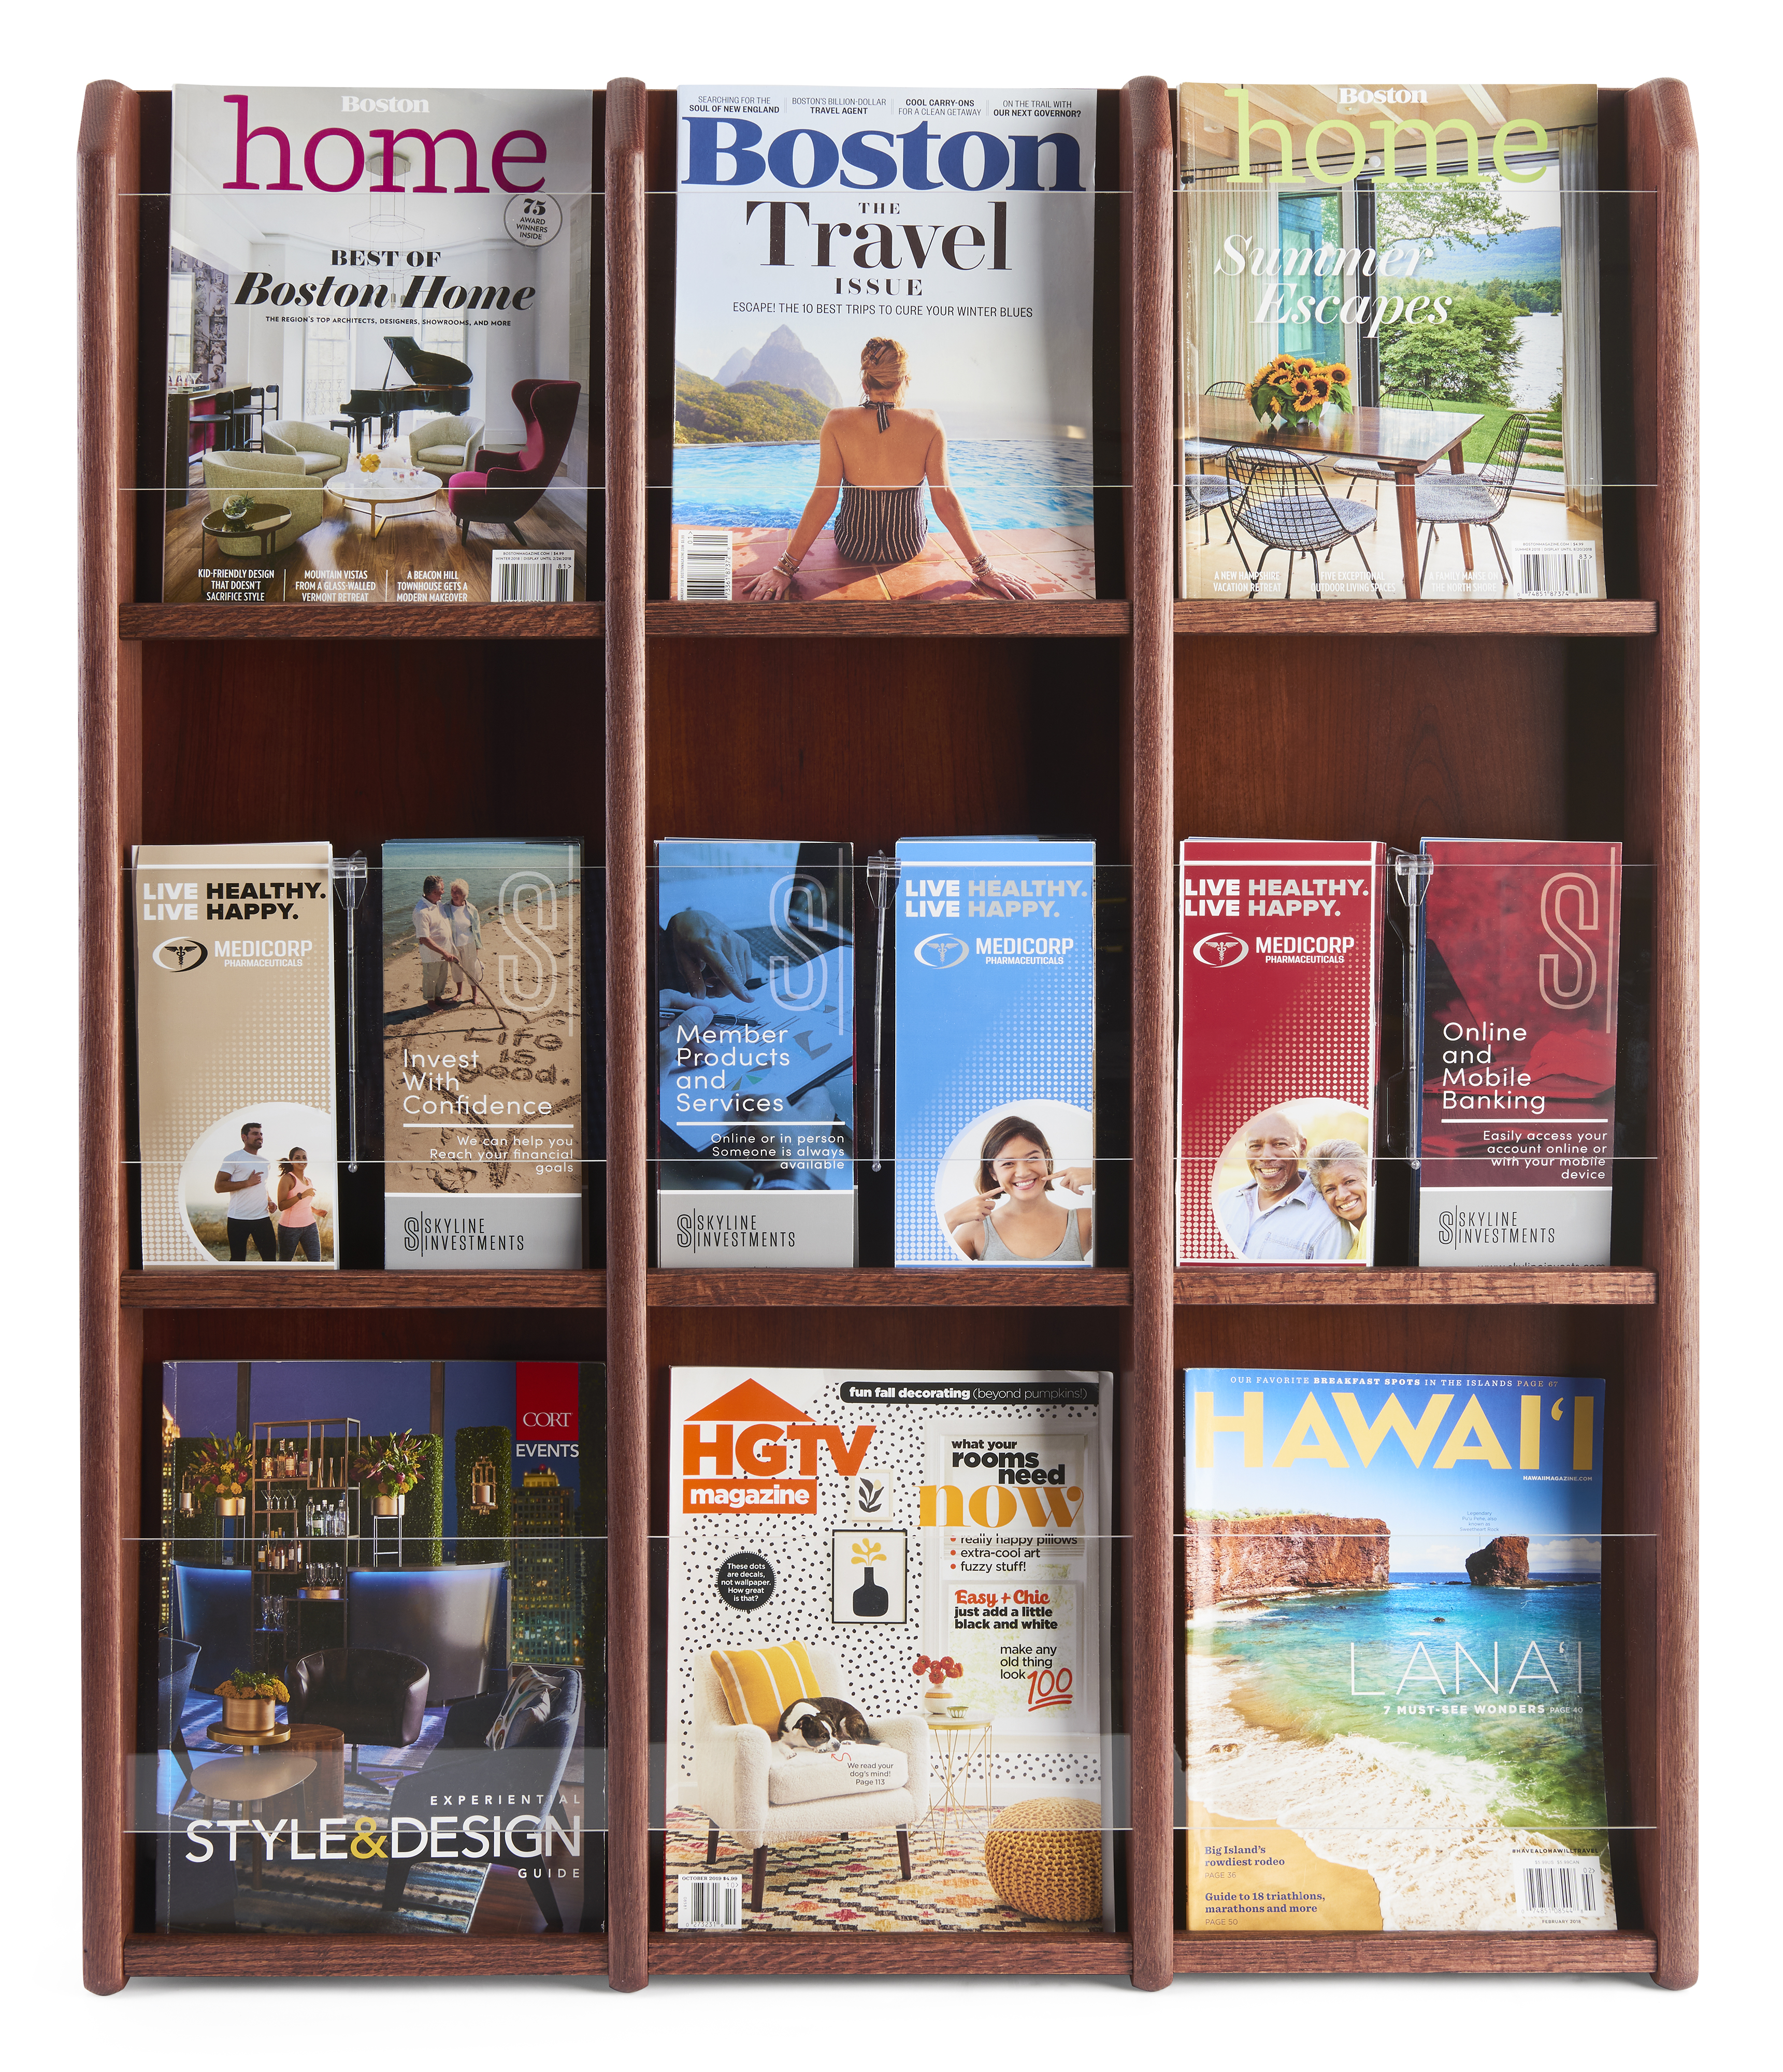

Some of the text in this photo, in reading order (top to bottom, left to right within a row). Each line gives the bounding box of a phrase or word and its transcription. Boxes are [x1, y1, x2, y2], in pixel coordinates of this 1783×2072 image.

[341, 96, 430, 113] Boston
[698, 95, 771, 105] SEARCHING FOR THE
[1339, 88, 1428, 105] Boston
[742, 106, 780, 114] ENGLAND
[222, 94, 548, 193] home
[1224, 88, 1549, 184] home
[681, 116, 1087, 192] Boston
[523, 198, 547, 215] 75
[858, 202, 900, 214] THE
[516, 223, 548, 233] WINNERS
[520, 217, 546, 225] AWARD
[520, 232, 542, 240] INSIDE
[746, 200, 1012, 270] Travel
[330, 250, 441, 268] BEST OF
[1213, 234, 1435, 278] Summer
[230, 271, 536, 311] Boston Home
[833, 277, 923, 296] ISSUE
[733, 302, 1033, 318] ESCAPE! THE 10 BEST TRIPS TO CURE YOUR WINTER BLUES
[1249, 282, 1453, 339] Escapes
[198, 569, 275, 579] KID-FRIENDLY DESIGN
[1214, 571, 1281, 581] A NEW HAMPSHIRE
[211, 580, 229, 590] THAT
[1213, 582, 1282, 592] VACATION RETREAT
[206, 592, 265, 601] SACRIFICE STYLE
[143, 882, 326, 900] LIVE HEALTHY.
[905, 880, 1087, 897] LIVE HEALTHY.
[1185, 879, 1369, 897] LIVE HEALTHY.
[143, 903, 299, 920] LIVE HAPPY.
[905, 900, 1060, 918] LIVE HAPPY.
[1185, 899, 1341, 917] LIVE HAPPY.
[214, 940, 313, 957] MEDICORP
[976, 938, 1074, 955] MEDICORP
[1256, 936, 1355, 954] MEDICORP
[224, 959, 303, 968] PHARMACEUTICALS
[985, 956, 1063, 965] PHARMACEUTICALS
[1265, 955, 1344, 963] PHARMACEUTICALS
[676, 1023, 788, 1044] Member
[1443, 1020, 1528, 1042] Online
[404, 1048, 479, 1069] Invest
[677, 1046, 790, 1067] Products
[1442, 1044, 1492, 1064] and
[402, 1071, 459, 1091] With
[676, 1069, 726, 1089] and
[1442, 1067, 1532, 1087] Mobile
[403, 1095, 552, 1115] Confidence
[676, 1092, 784, 1112] Services
[1442, 1089, 1546, 1115] Banking
[456, 1135, 573, 1149] We can help you
[430, 1148, 574, 1162] Reach your financial
[536, 1162, 574, 1175] goals
[425, 1218, 485, 1234] SKYLINE
[697, 1215, 756, 1230] SKYLINE
[1459, 1212, 1517, 1227] SKYLINE
[425, 1235, 524, 1251] INVESTMENTS
[698, 1231, 796, 1247] INVESTMENTS
[1458, 1227, 1555, 1244] INVESTMENTS
[849, 1386, 1088, 1400] fun fall decorating (beyond pumpkins!)
[523, 1412, 572, 1427] CORT
[516, 1444, 580, 1458] EVENTS
[683, 1423, 878, 1477] HGTV
[951, 1439, 1017, 1451] what your
[952, 1451, 1040, 1468] rooms
[998, 1463, 1066, 1485] need
[690, 1484, 810, 1508] magazine
[912, 1484, 1085, 1529] now
[960, 1547, 1041, 1558] extra-cool art
[960, 1561, 1027, 1573] fuzzy stuff!
[1000, 1667, 1073, 1705] look 100
[1383, 1706, 1391, 1715] 7
[1397, 1705, 1468, 1715] MUST-SEE
[1473, 1704, 1545, 1714] WONDERS
[185, 1815, 581, 1863] STYLE&DESIGN
[1204, 1846, 1222, 1856] Big
[1204, 1857, 1285, 1867] rowdiest rodeo
[517, 1868, 580, 1879] GUIDE
[1205, 1891, 1326, 1902] Guide to 18 triathlons,
[1205, 1904, 1317, 1913] marathons and more
